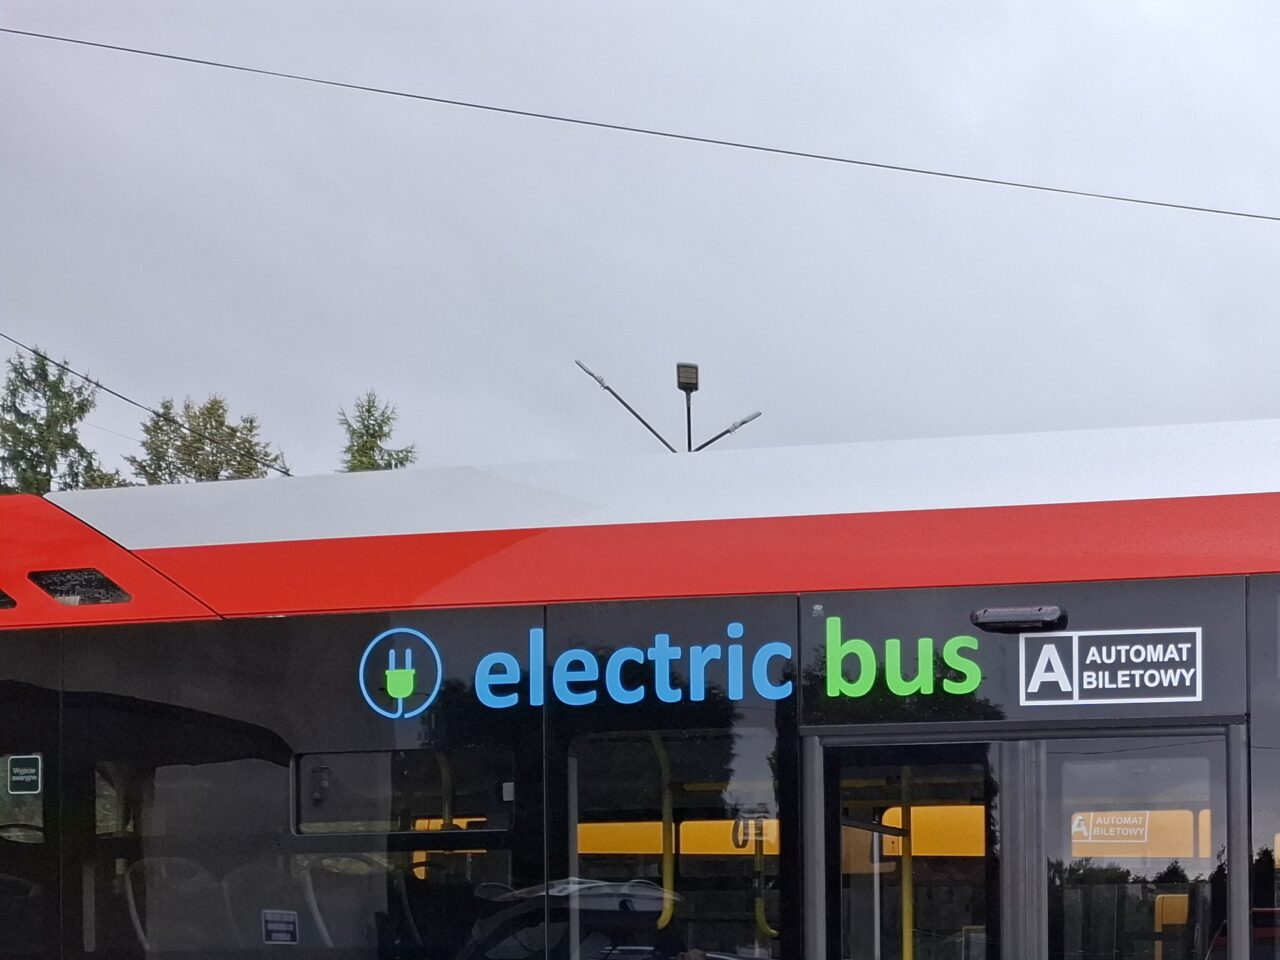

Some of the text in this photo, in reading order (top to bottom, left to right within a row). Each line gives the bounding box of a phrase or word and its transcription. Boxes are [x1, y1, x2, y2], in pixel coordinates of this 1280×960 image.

[475, 616, 983, 708] electric bus
[1085, 643, 1192, 664] AUTOMAT
[1027, 644, 1073, 693] A
[1083, 668, 1196, 689] BILETOWY
[1095, 816, 1144, 825] AUTOMAT
[1093, 827, 1145, 836] BILETOWY
